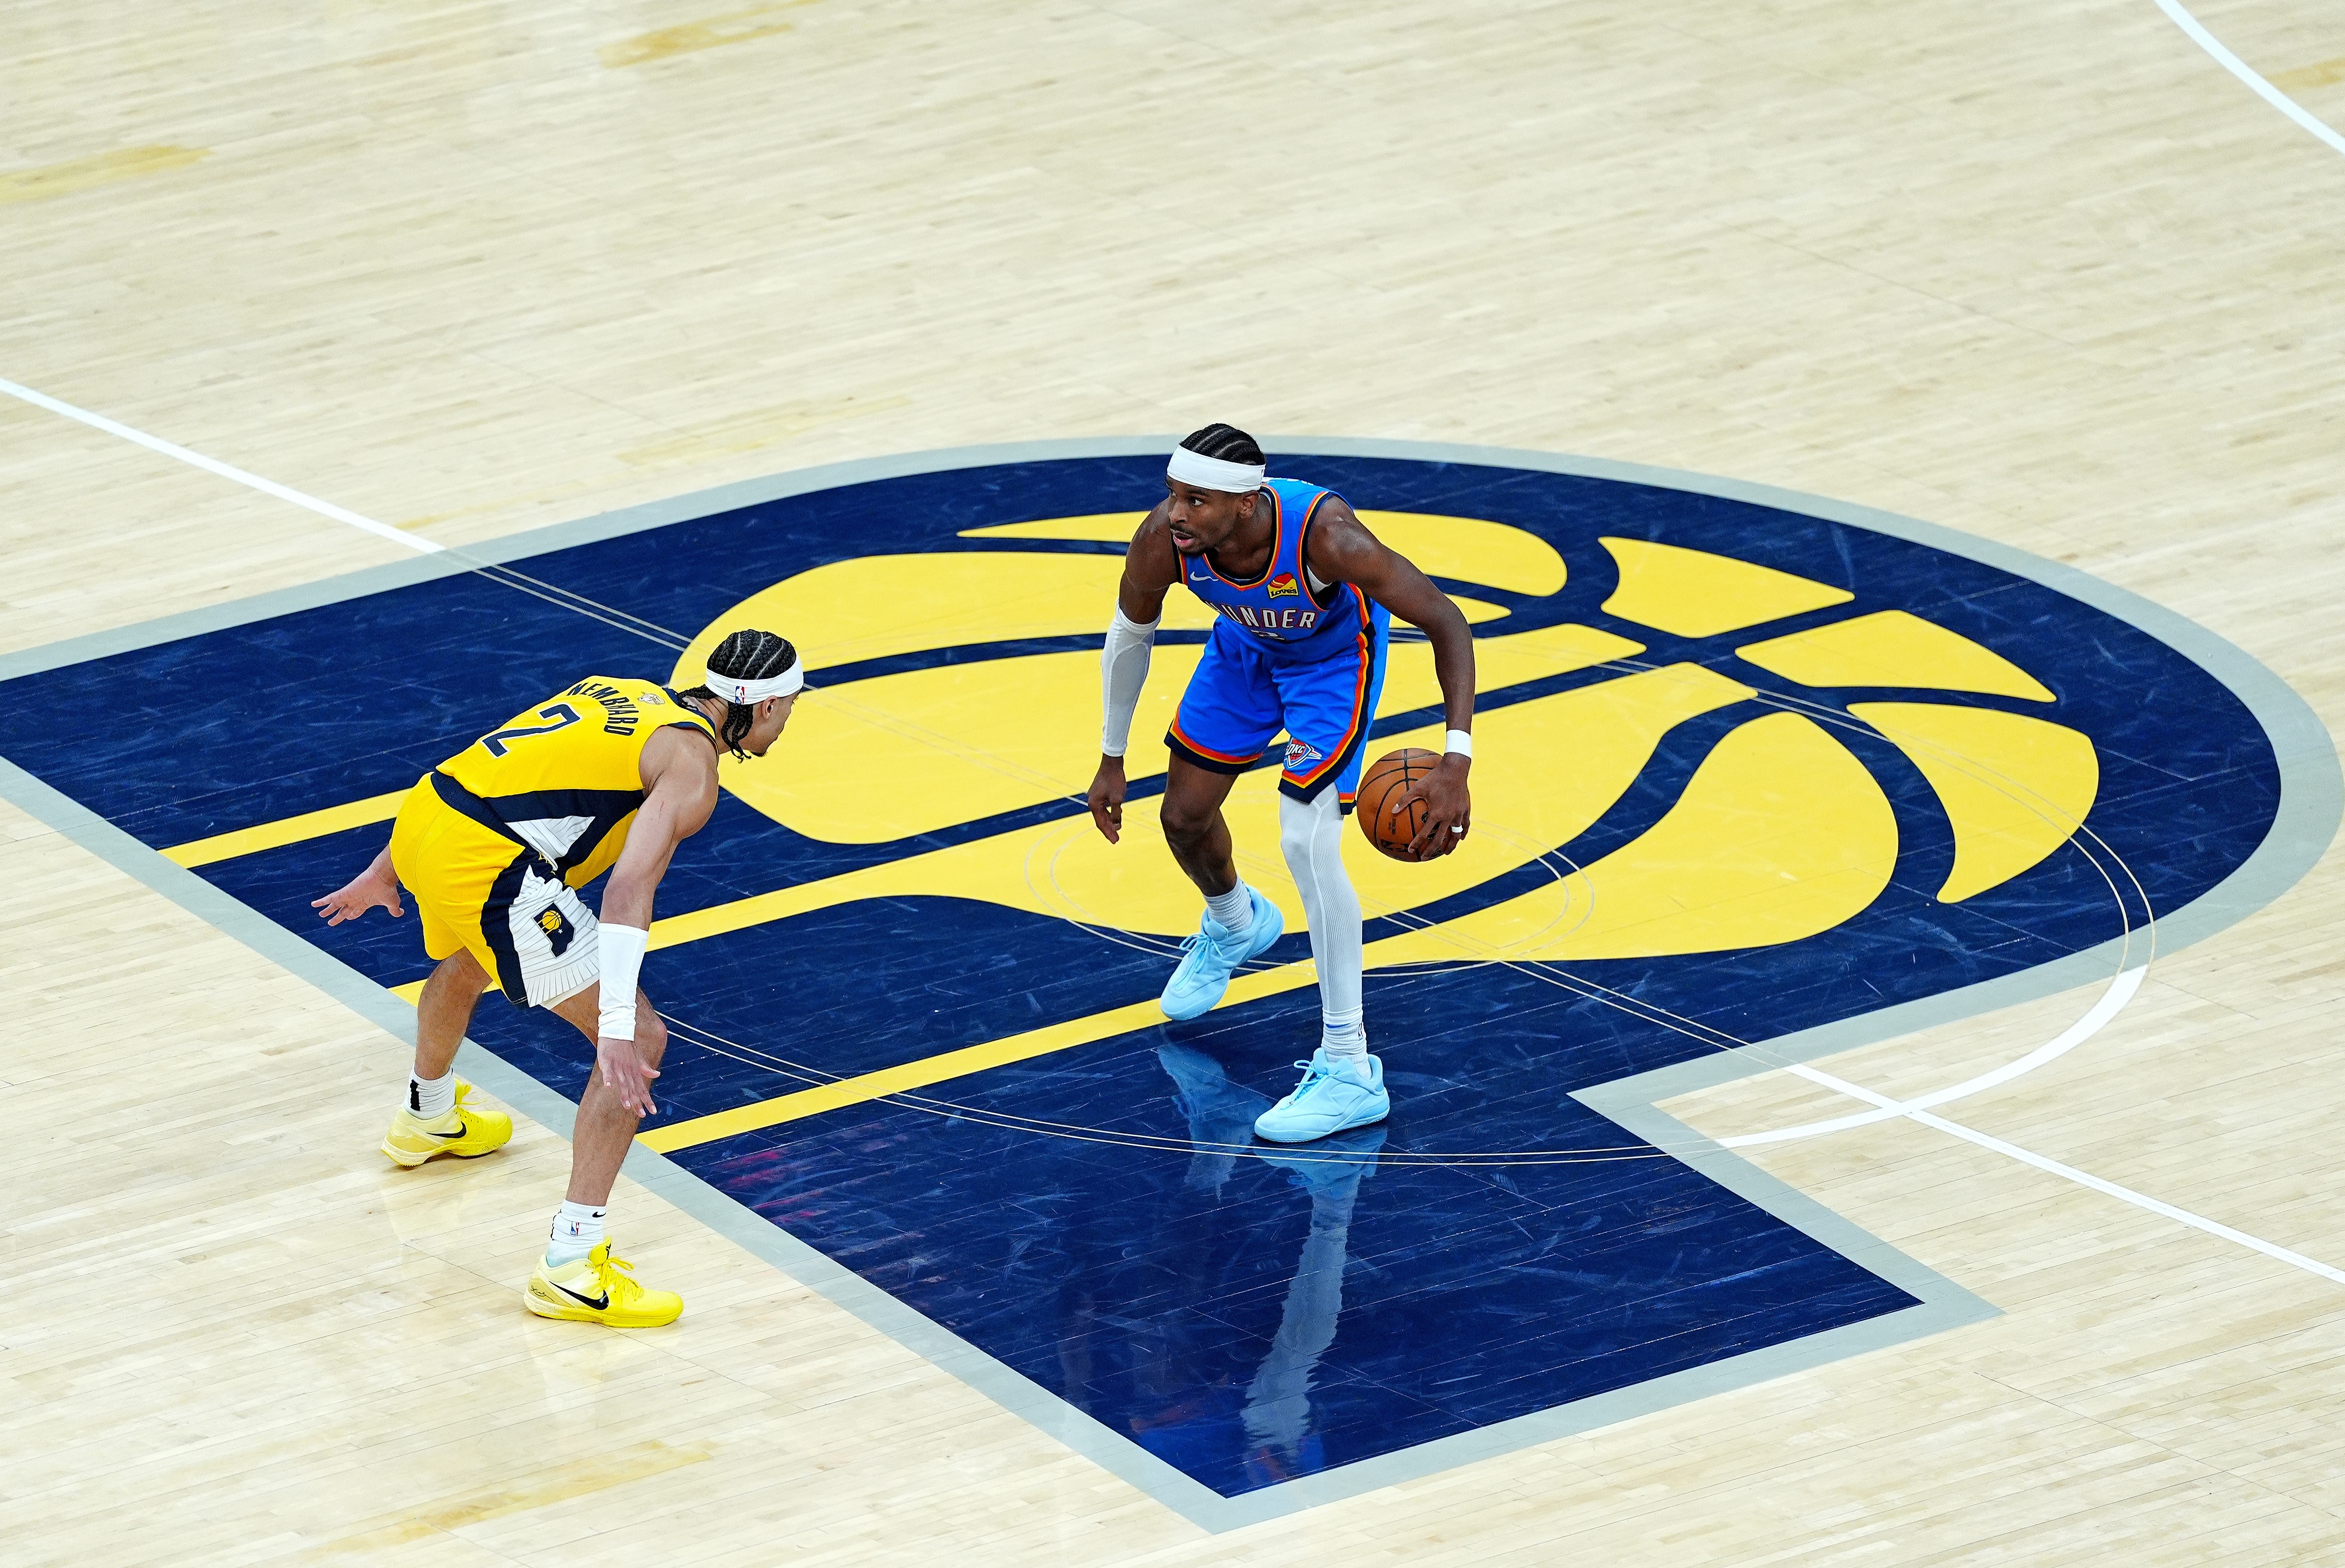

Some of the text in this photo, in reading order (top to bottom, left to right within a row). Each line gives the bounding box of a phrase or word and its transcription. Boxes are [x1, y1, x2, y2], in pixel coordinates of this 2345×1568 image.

[1204, 600, 1317, 628] UNDER
[566, 682, 639, 736] NEMBHARD
[480, 703, 582, 758] 2
[1285, 744, 1305, 756] OKC
